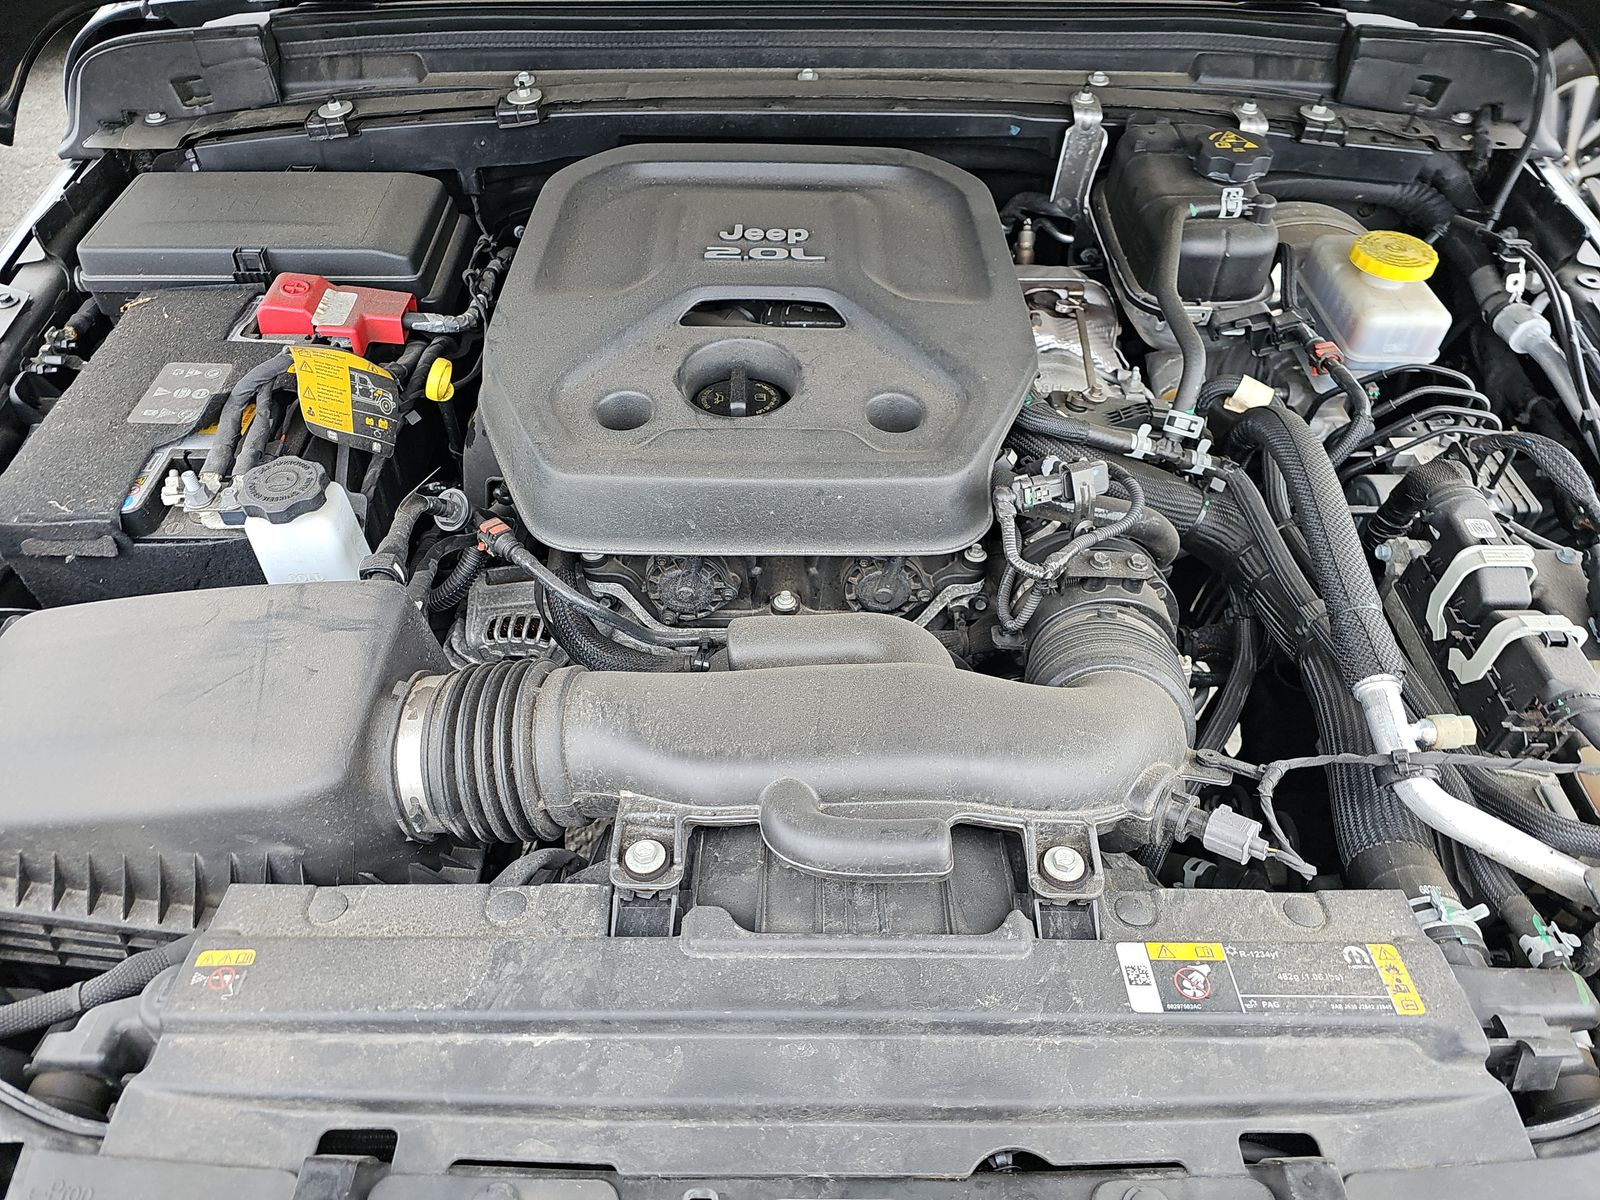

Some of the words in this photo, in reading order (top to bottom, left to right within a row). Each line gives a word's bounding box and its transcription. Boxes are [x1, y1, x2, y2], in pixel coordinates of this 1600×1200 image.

[719, 223, 810, 245] Jeep
[703, 246, 827, 261] 2.0L
[1261, 1001, 1281, 1009] PAG
